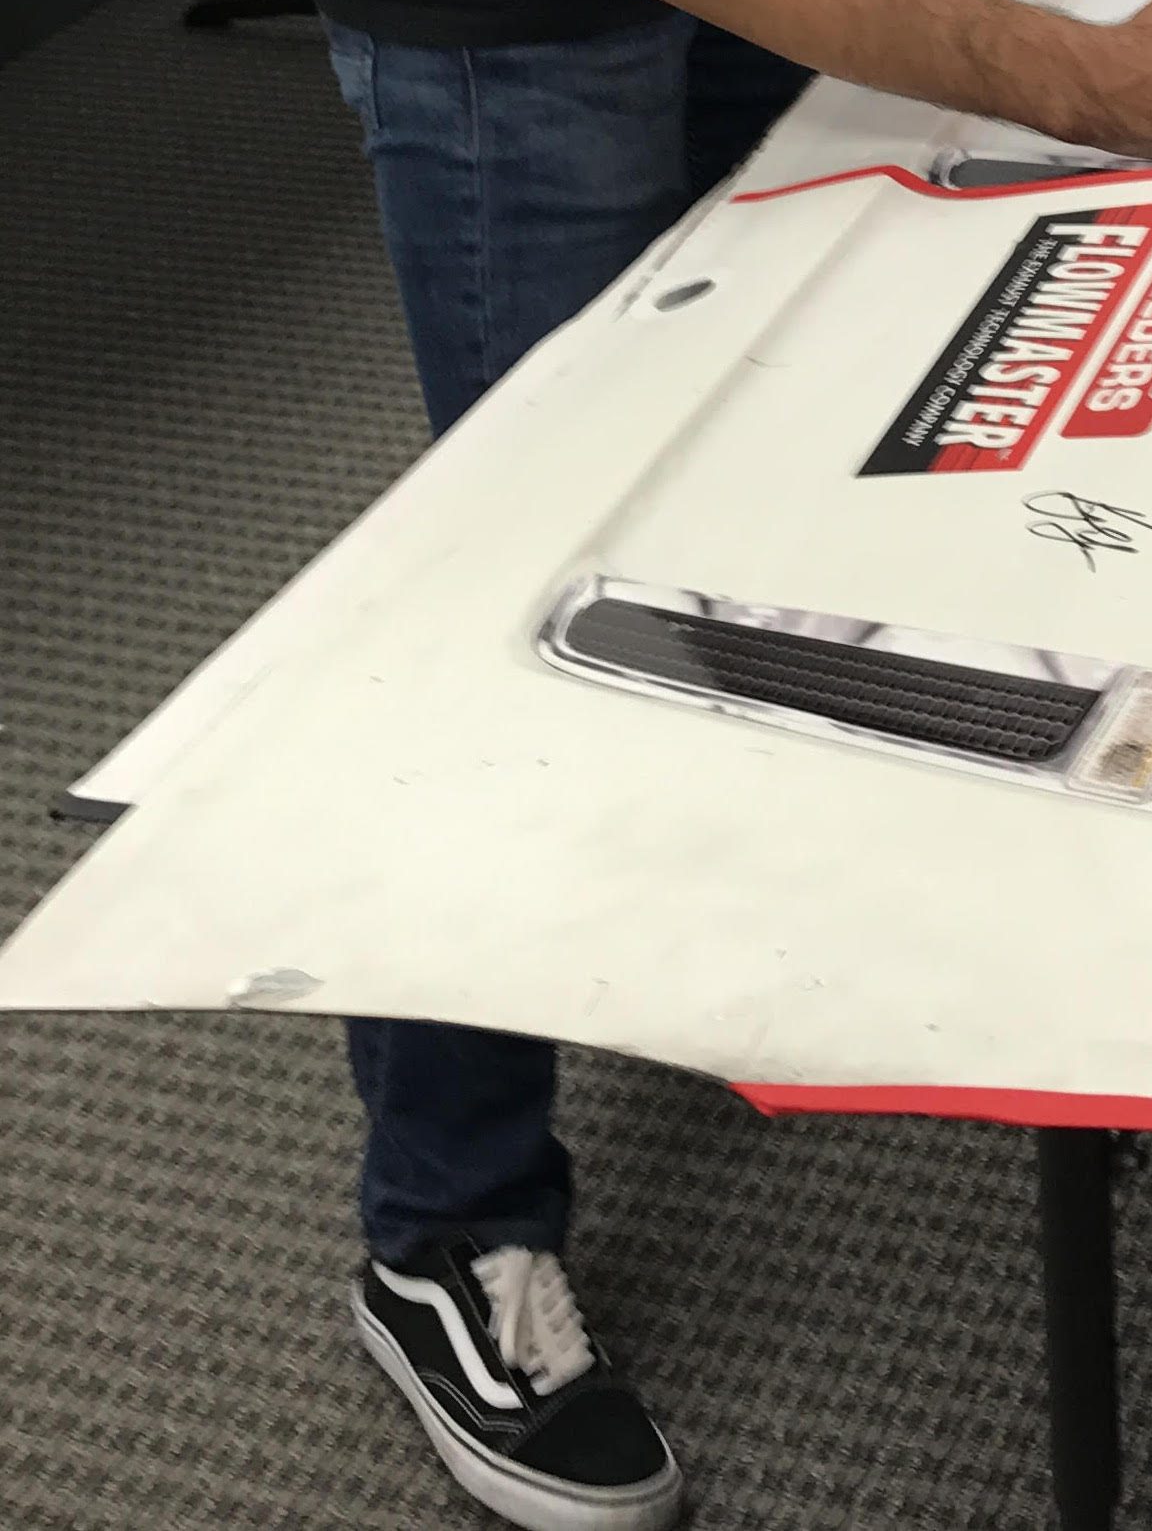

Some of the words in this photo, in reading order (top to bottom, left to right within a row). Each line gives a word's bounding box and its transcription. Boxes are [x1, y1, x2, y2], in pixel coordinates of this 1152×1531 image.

[1029, 237, 1059, 260] THE
[998, 259, 1044, 306] EXHAUST
[932, 221, 1152, 450] FLOWMASTER
[943, 309, 1012, 386] TECHNOLOGY
[901, 385, 959, 447] COMPANY
